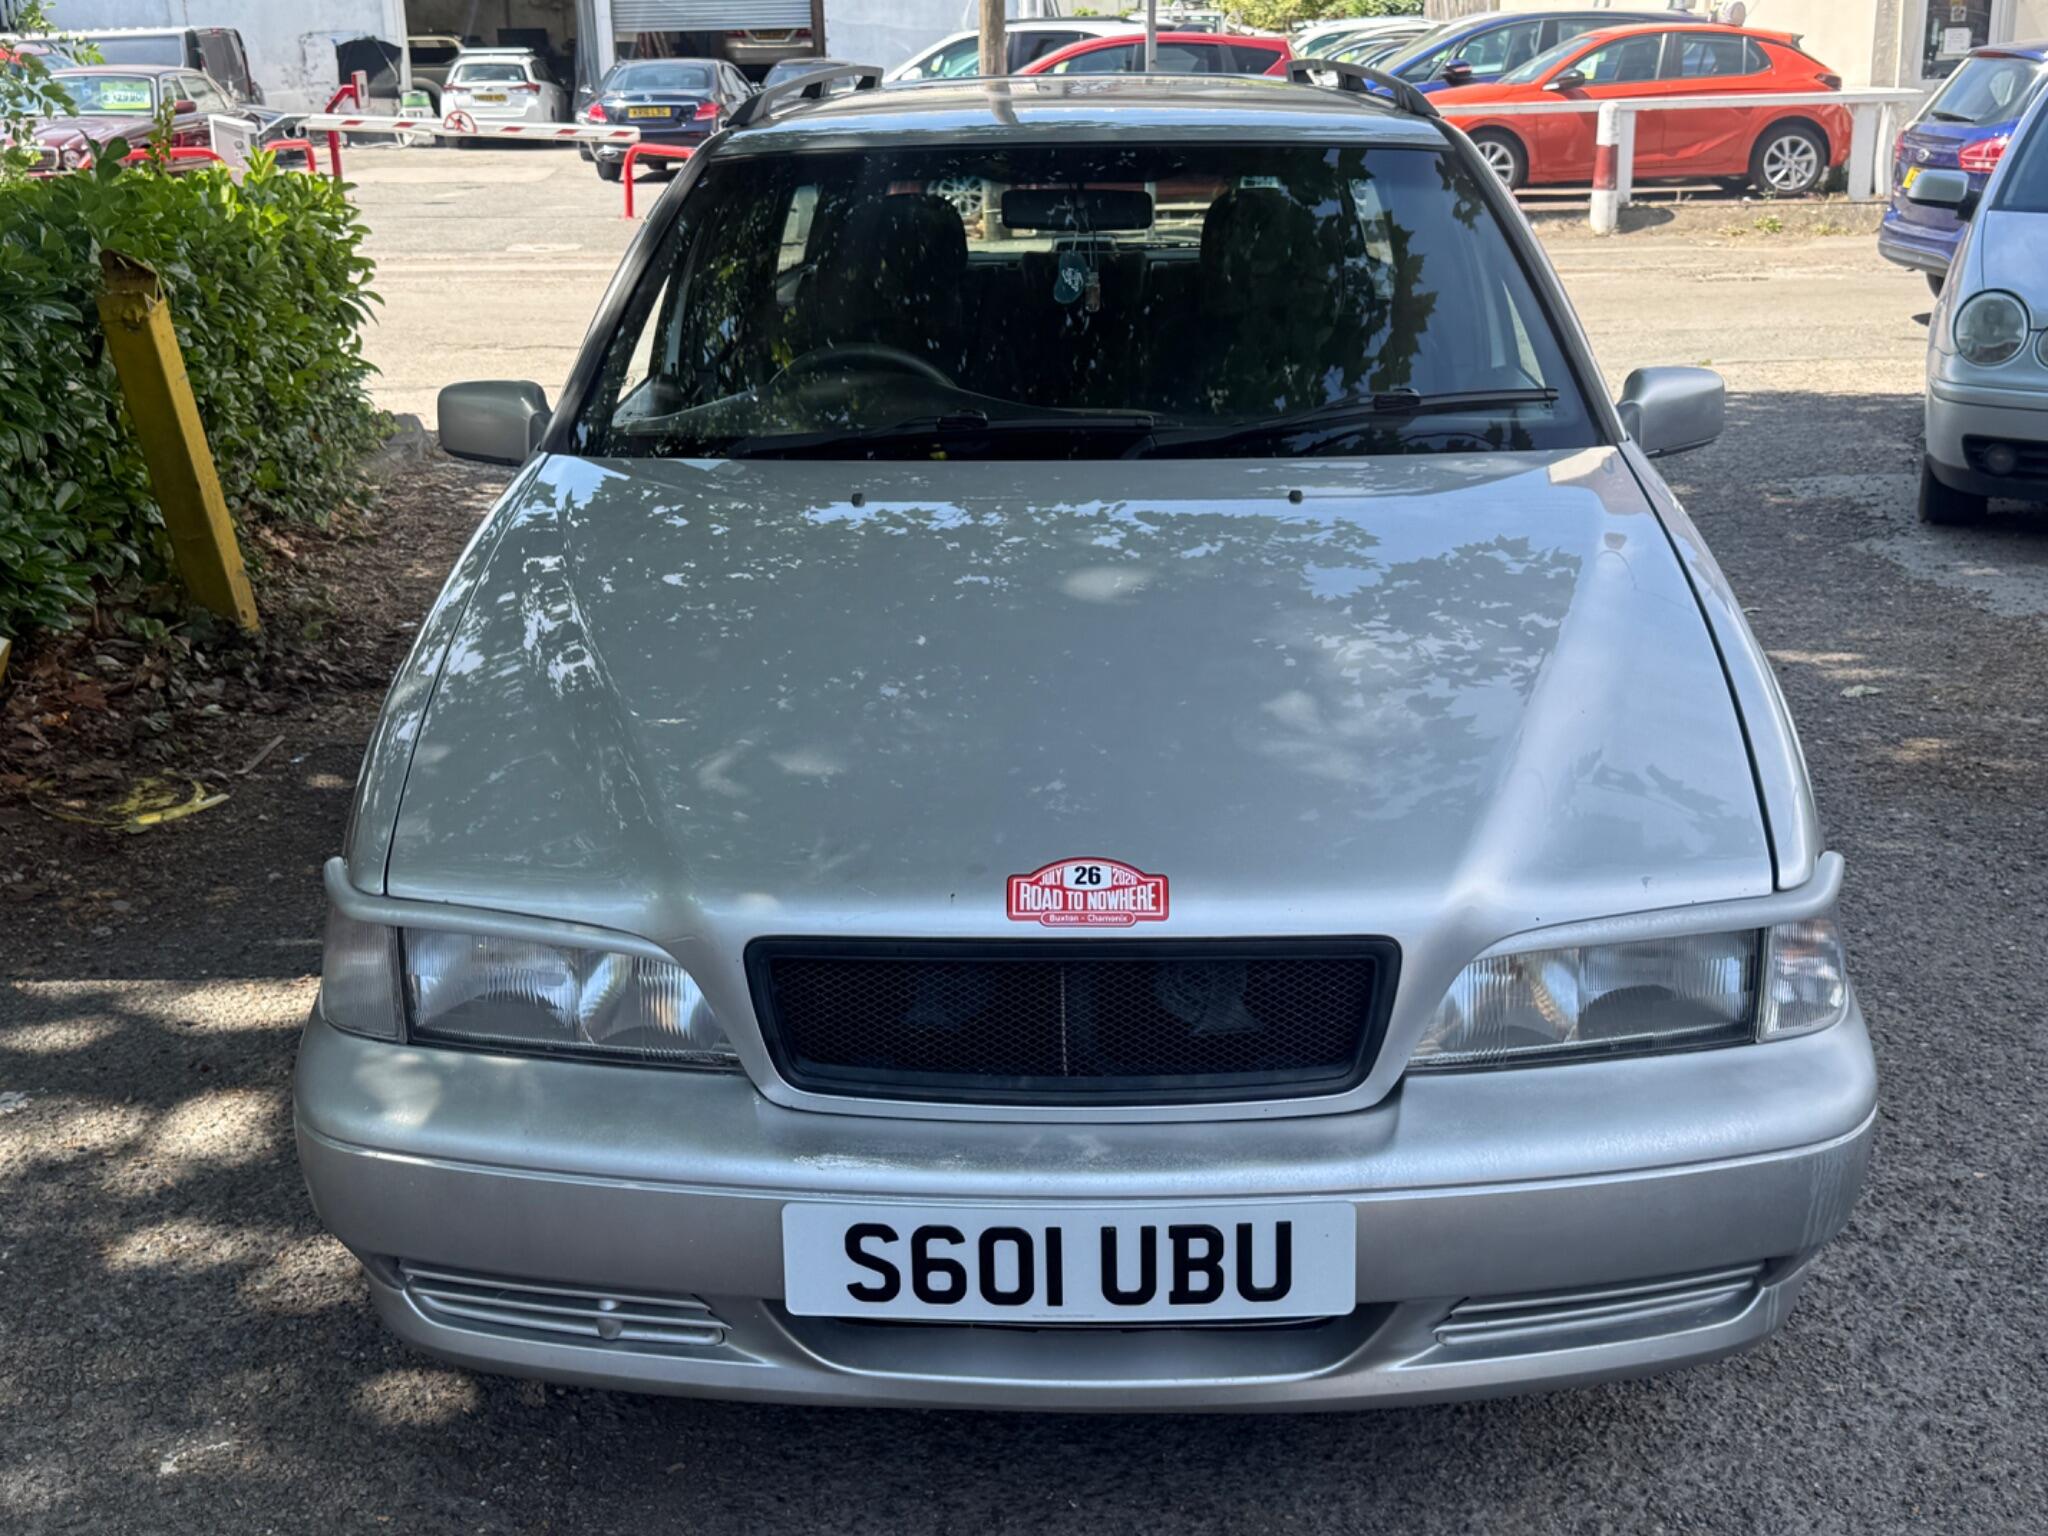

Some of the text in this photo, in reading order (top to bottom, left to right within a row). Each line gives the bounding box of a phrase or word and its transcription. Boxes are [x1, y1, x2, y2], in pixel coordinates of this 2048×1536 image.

[1039, 868, 1062, 886] JULY
[1074, 866, 1101, 885] 26
[1019, 883, 1156, 910] ROAD TO NOWHERE
[1049, 914, 1079, 923] Buxton
[1087, 914, 1128, 923] Chamonix
[844, 1221, 1293, 1306] S601 UBU
